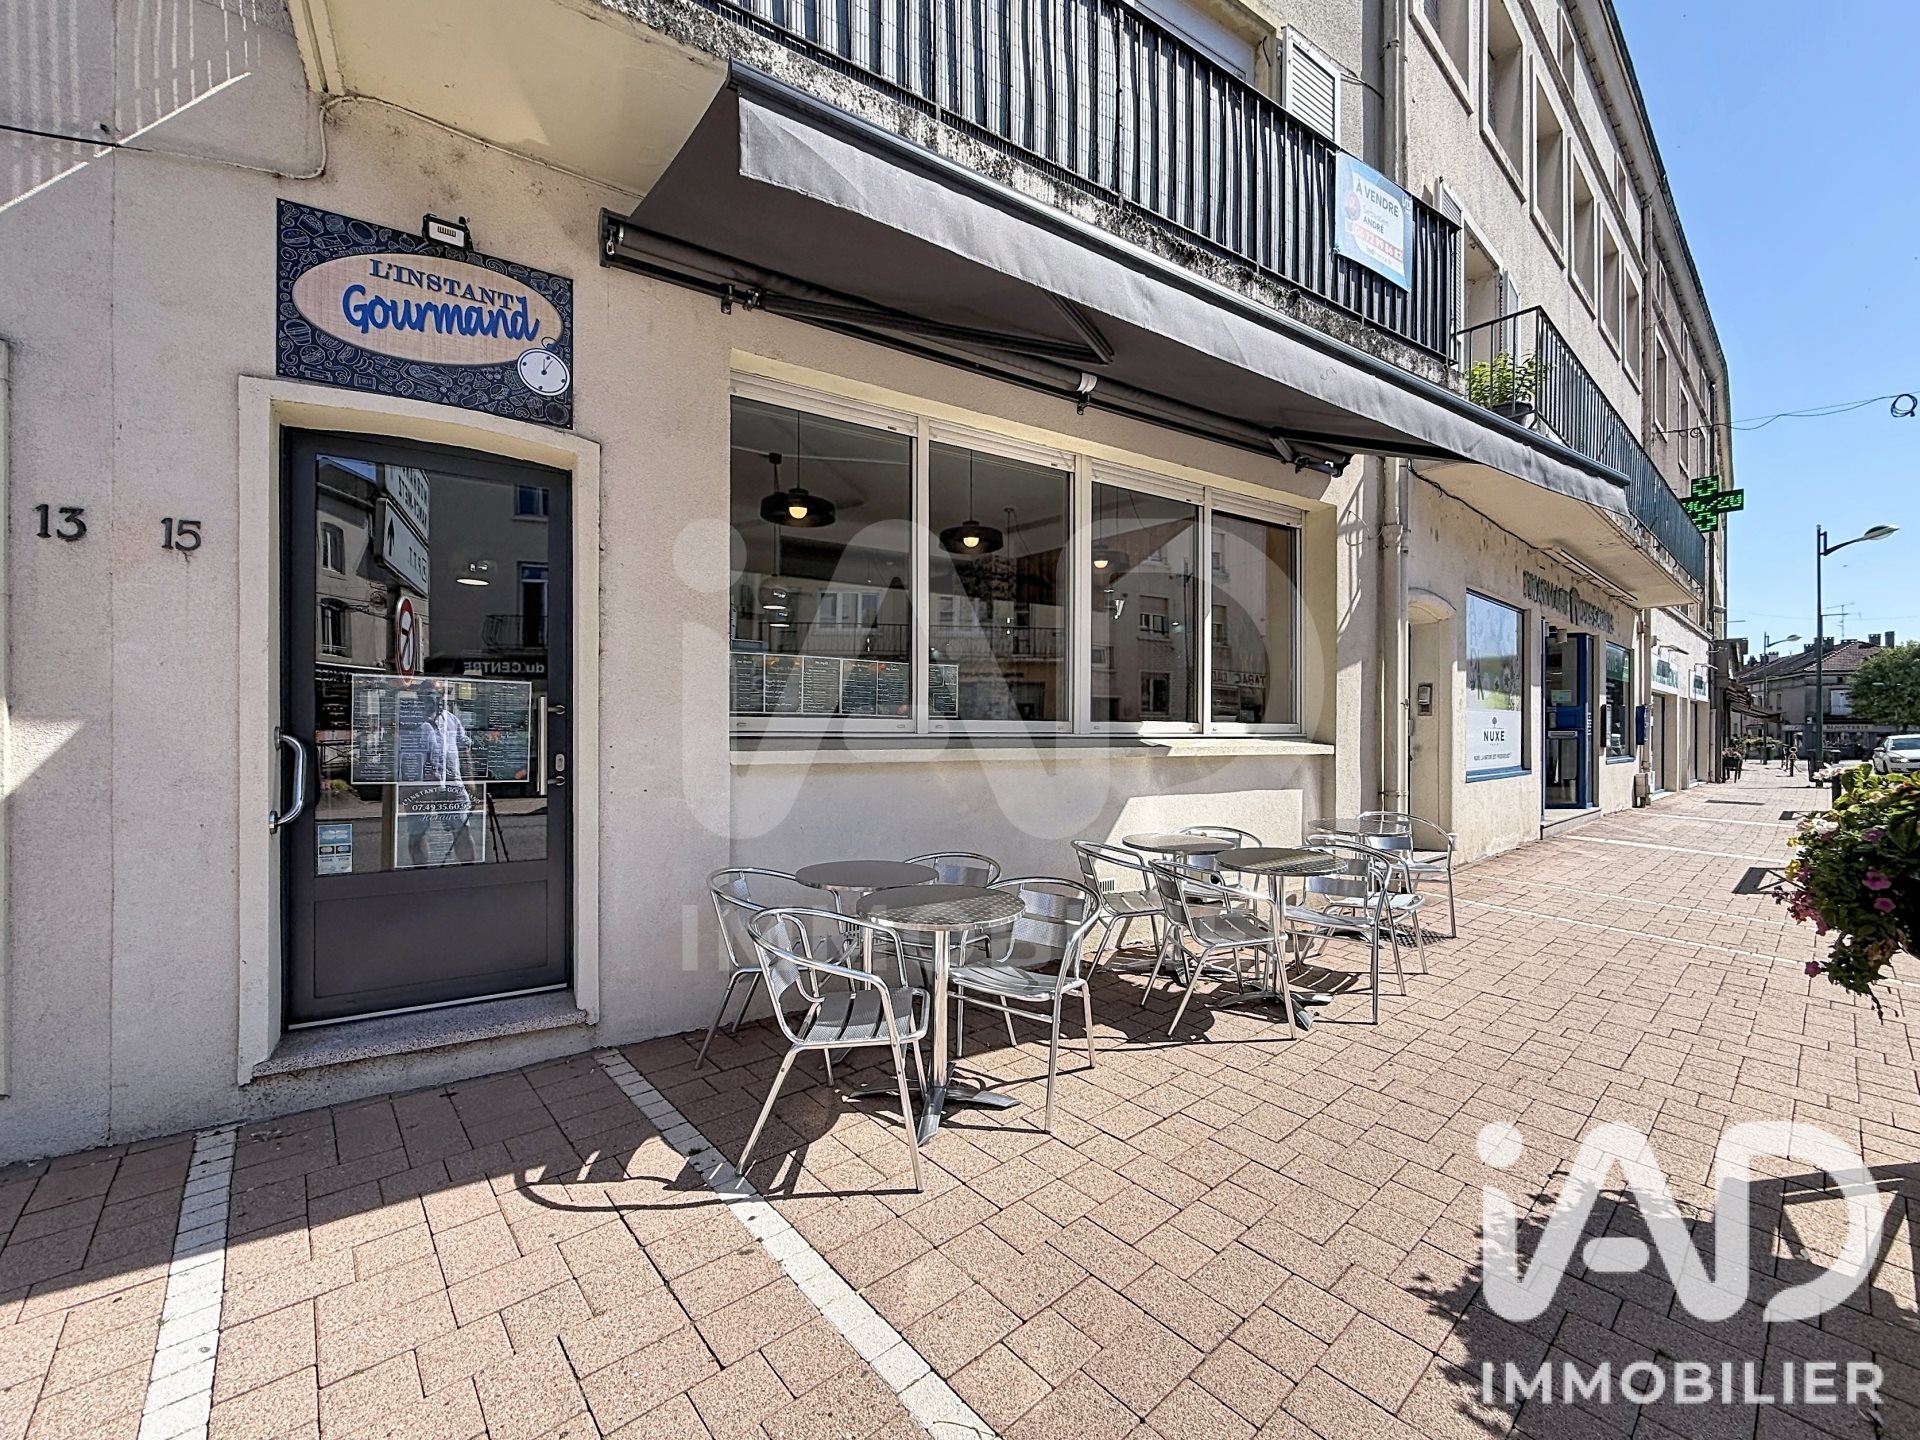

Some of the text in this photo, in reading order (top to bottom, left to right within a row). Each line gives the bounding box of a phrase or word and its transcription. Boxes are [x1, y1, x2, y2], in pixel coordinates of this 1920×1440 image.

[1364, 185, 1399, 218] VENDRE
[1363, 215, 1385, 234] ANDRÉ
[369, 258, 515, 310] L'INSTANT
[342, 284, 540, 342] Gourmand
[34, 503, 88, 542] 13
[160, 517, 202, 551] 15
[1483, 730, 1505, 742] NUXE
